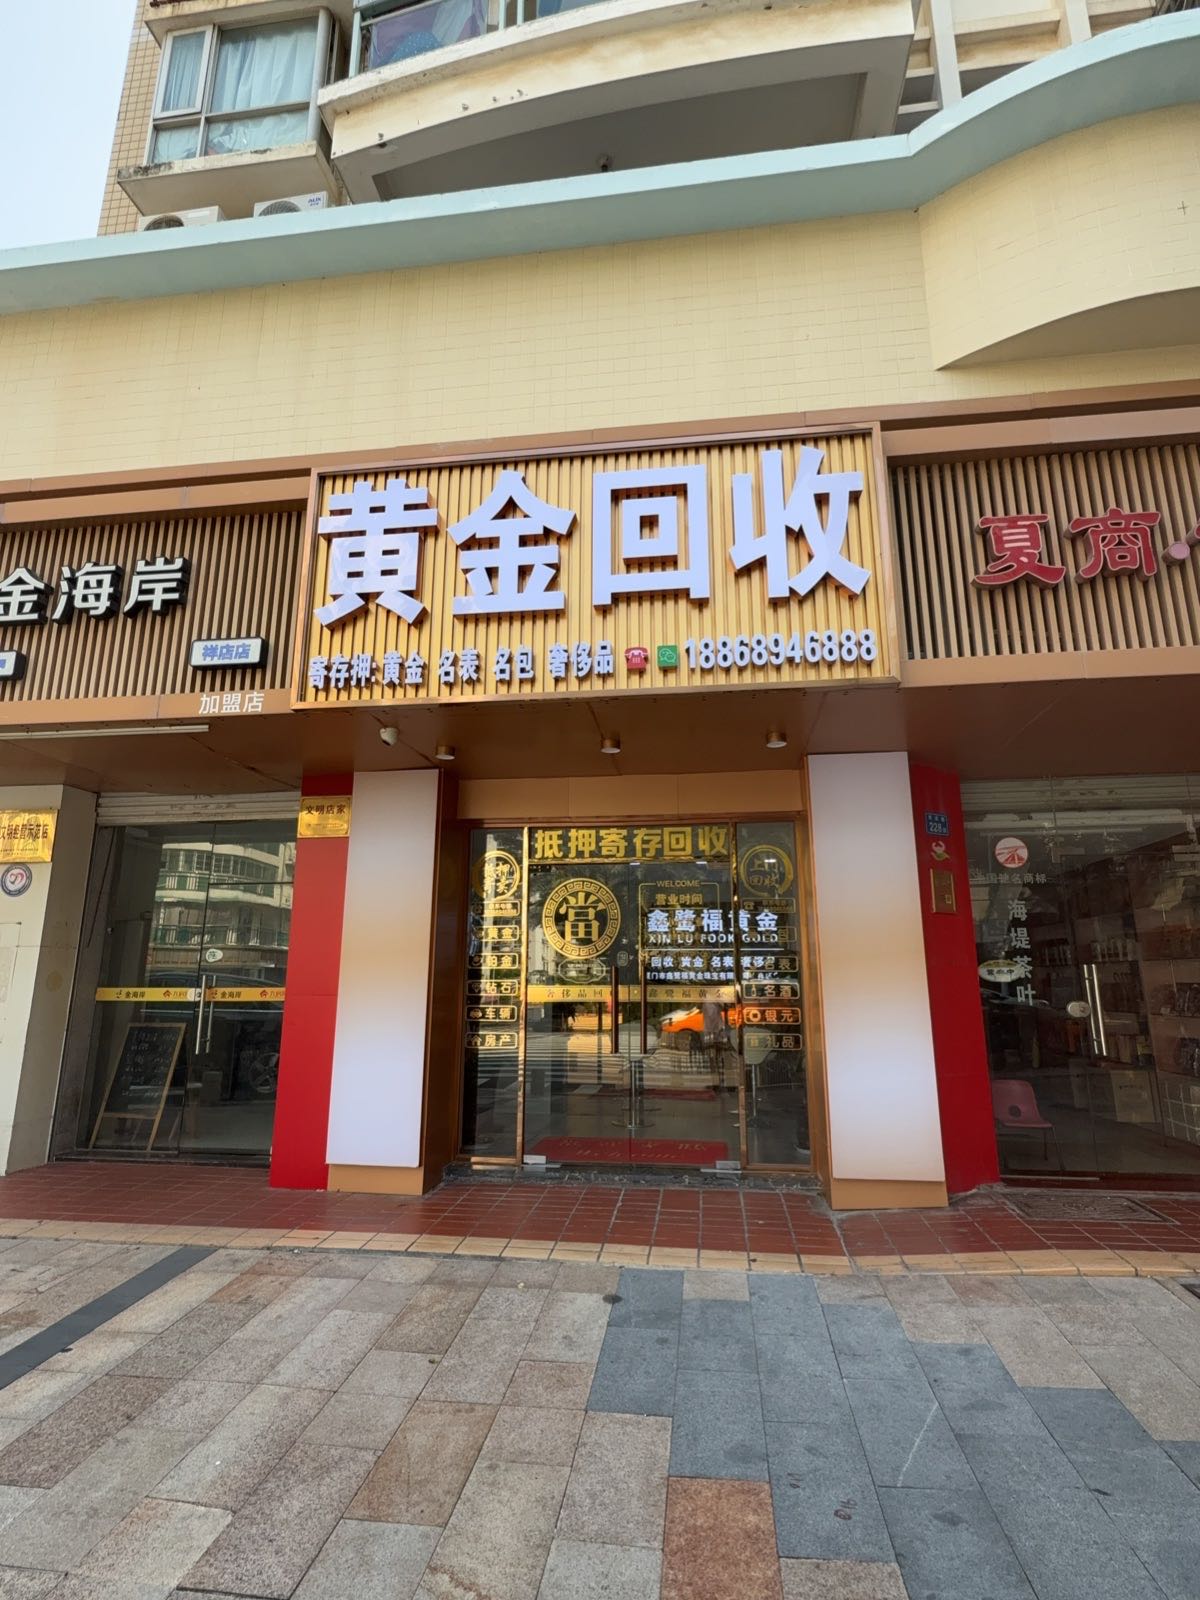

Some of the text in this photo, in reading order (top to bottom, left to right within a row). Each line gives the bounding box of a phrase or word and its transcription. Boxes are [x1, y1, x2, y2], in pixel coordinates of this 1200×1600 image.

[314, 445, 871, 626] 黄金回收
[438, 647, 479, 686] 名表
[495, 645, 534, 681] 名包
[549, 640, 615, 679] 奢侈品
[684, 629, 878, 671] 18868946888
[199, 691, 265, 714] 加盟店
[534, 826, 727, 859] 抵押寄存回收
[656, 880, 700, 888] WELCOME
[656, 894, 703, 905] 营业时间
[677, 934, 693, 943] LU
[701, 934, 734, 943] FOOK
[1008, 900, 1036, 1006] 海堤茶叶
[651, 956, 674, 967] 回收
[486, 982, 511, 994] 钻石
[484, 1034, 511, 1047] 房产
